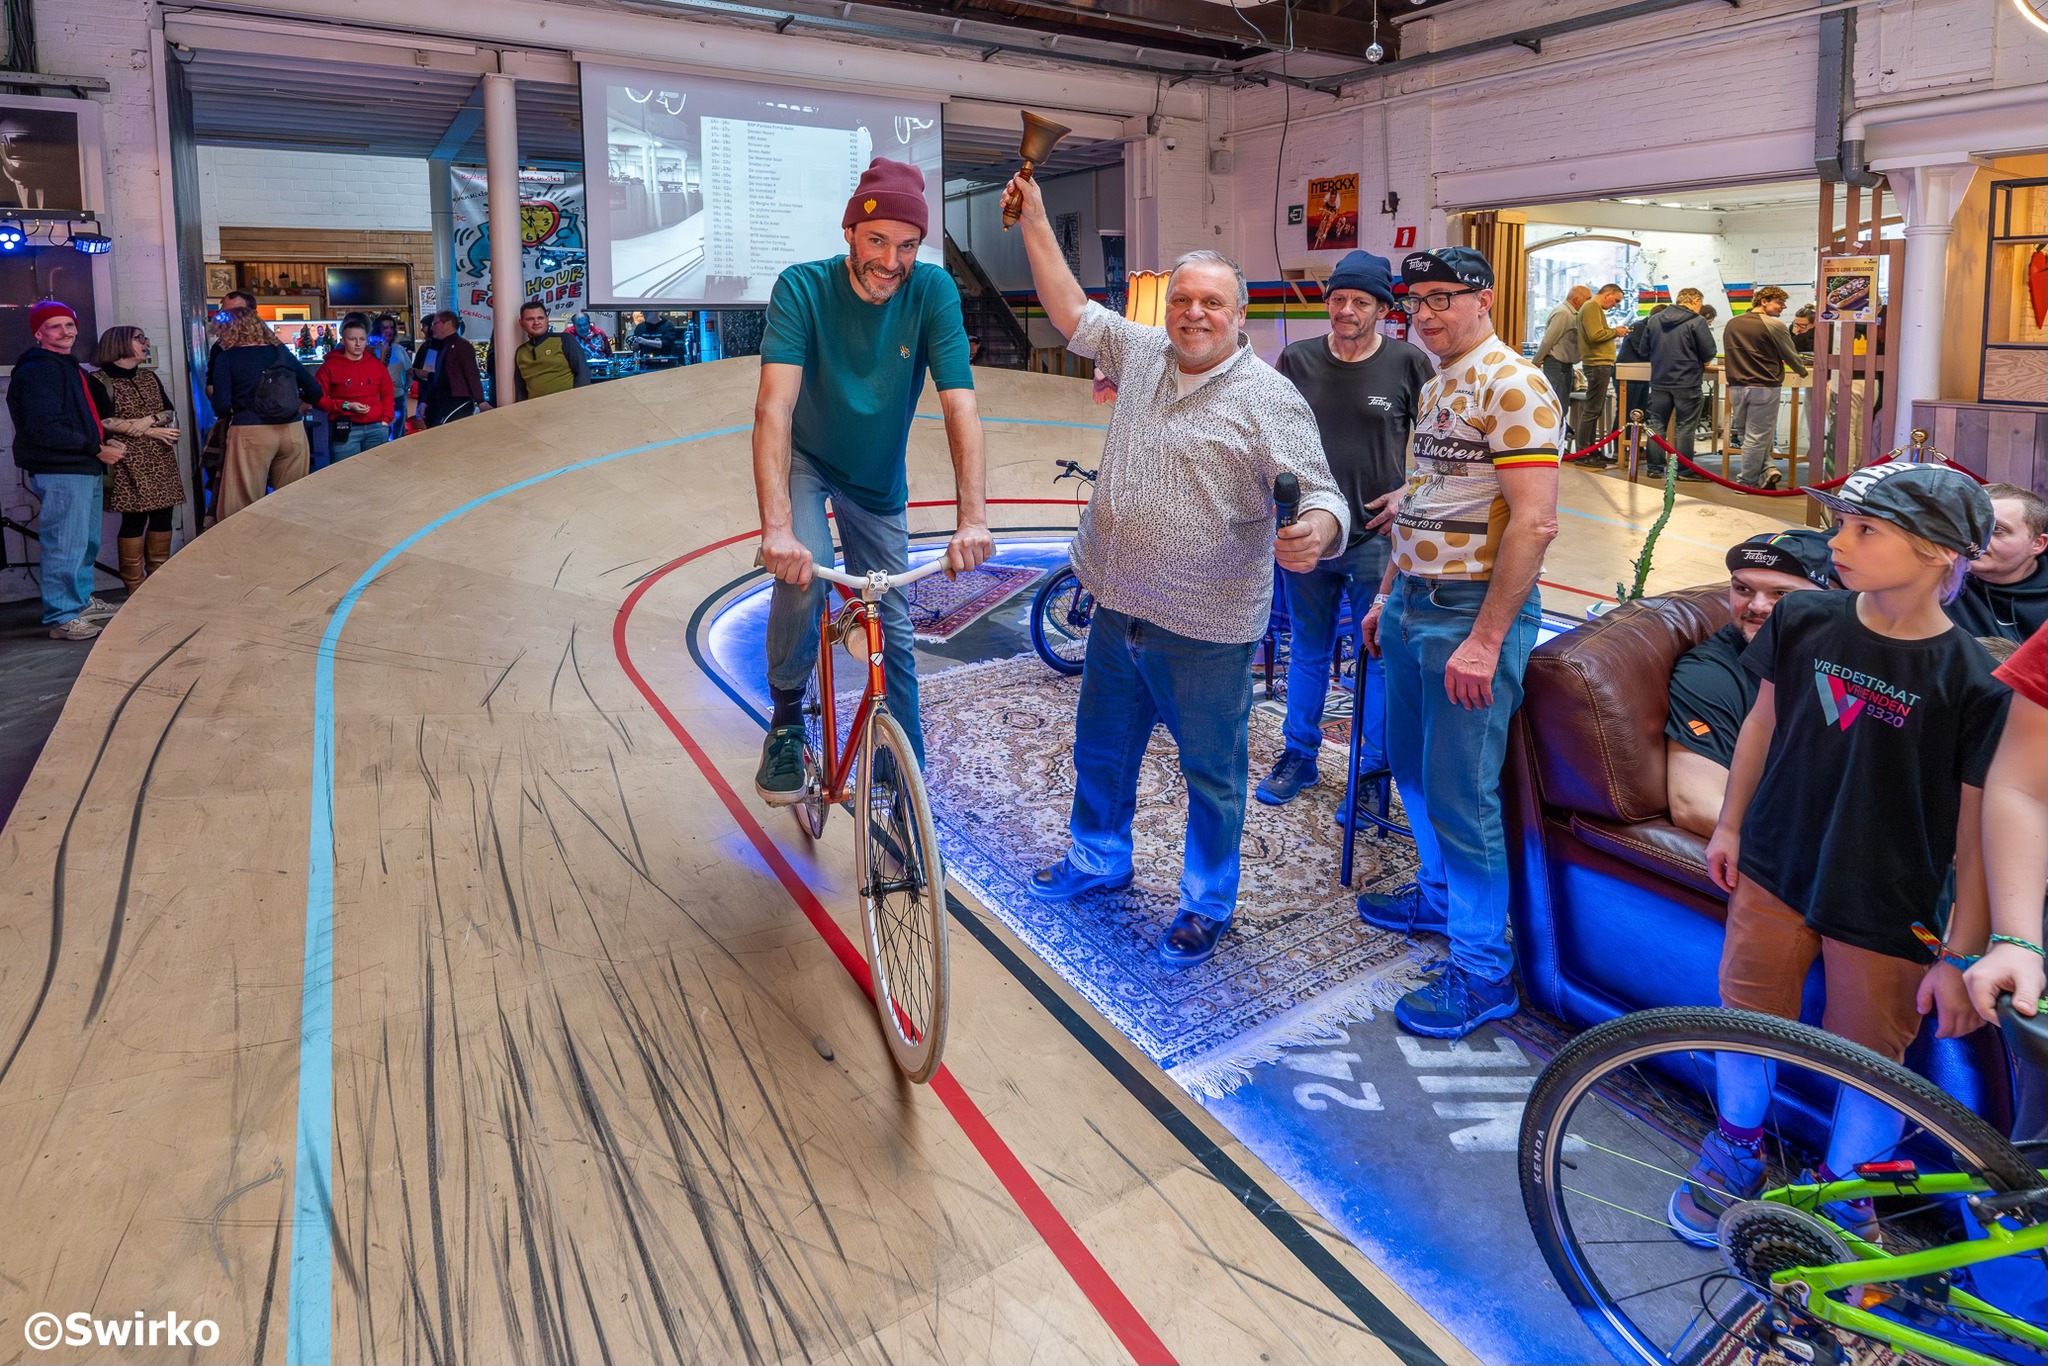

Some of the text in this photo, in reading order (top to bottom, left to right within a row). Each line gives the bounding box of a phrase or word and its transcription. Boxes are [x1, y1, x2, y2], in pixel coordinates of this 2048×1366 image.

[1311, 177, 1356, 194] MERCKX
[526, 266, 584, 296] HOUR
[531, 282, 583, 304] LIFE
[1422, 436, 1485, 461] Lucien
[1417, 519, 1443, 530] 1976
[1813, 658, 1921, 708] VREDESTRAAT
[1846, 681, 1912, 717] VRIENDEN
[1866, 703, 1905, 728] 9320
[1533, 1128, 1546, 1185] KENDA
